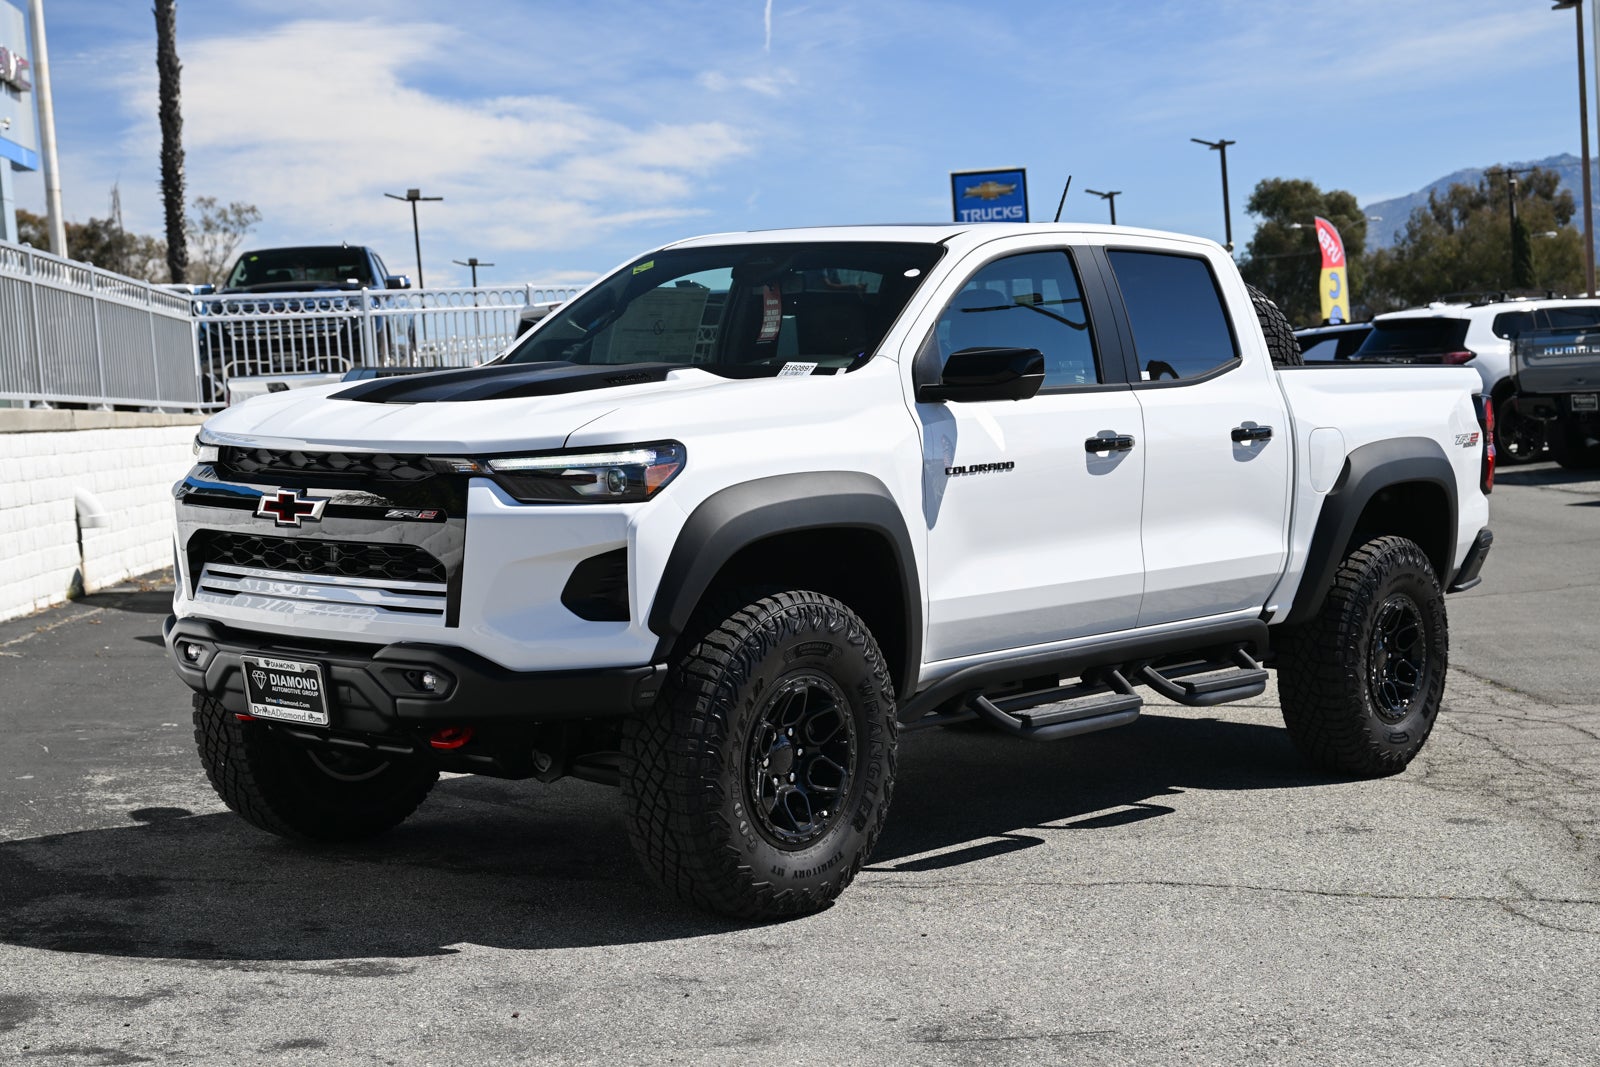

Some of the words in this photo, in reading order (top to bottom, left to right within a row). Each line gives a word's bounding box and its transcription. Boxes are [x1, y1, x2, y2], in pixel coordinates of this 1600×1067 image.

[960, 205, 1024, 222] TRUCKS
[1455, 432, 1480, 446] ZR2
[945, 461, 1015, 476] COLORADO
[384, 508, 439, 520] ZR2
[270, 661, 296, 671] DIAMOND
[269, 673, 318, 691] DIAMOND
[271, 686, 301, 696] AUTOMOTIVE
[792, 852, 845, 880] TERRITORY
